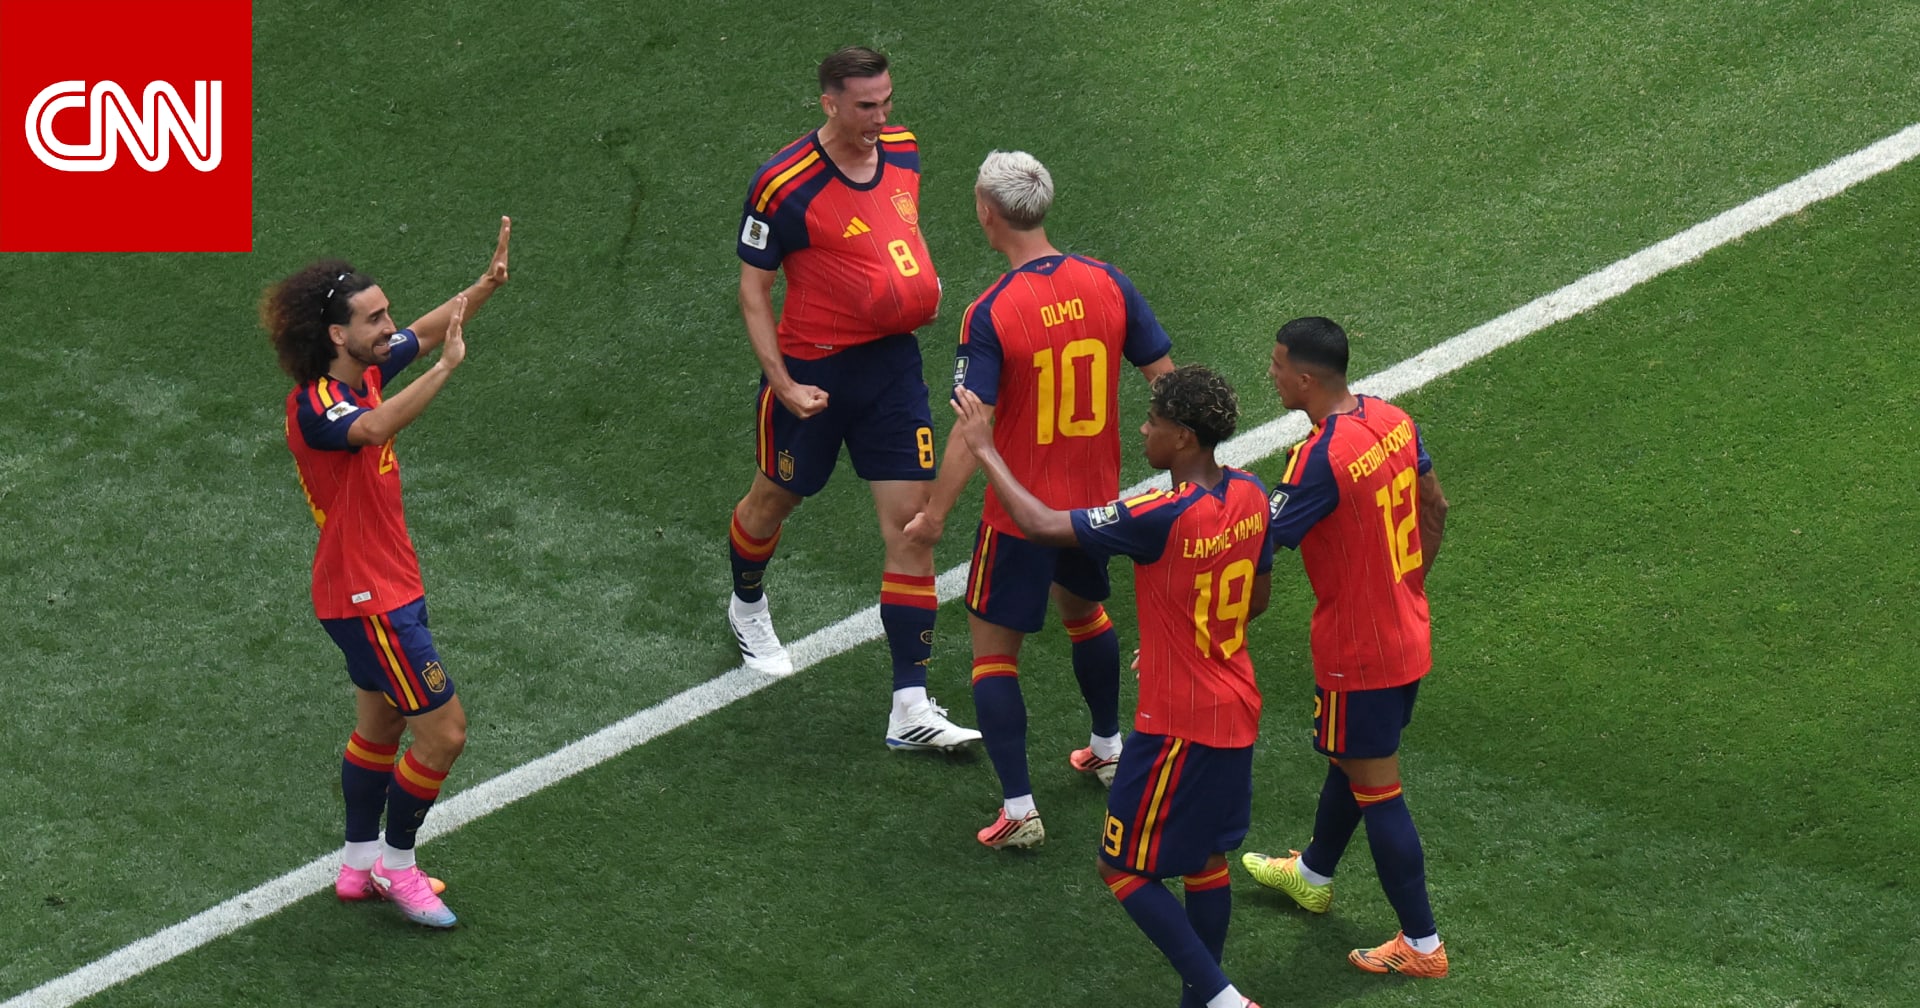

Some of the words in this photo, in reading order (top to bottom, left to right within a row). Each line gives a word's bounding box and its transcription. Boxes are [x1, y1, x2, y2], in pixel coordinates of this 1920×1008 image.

[887, 239, 920, 277] 8
[1040, 298, 1084, 327] OLMO
[1032, 338, 1107, 445] 10
[915, 426, 935, 469] 8
[1183, 527, 1232, 558] LAMINE
[1375, 466, 1423, 585] 12
[1194, 558, 1254, 660] 19
